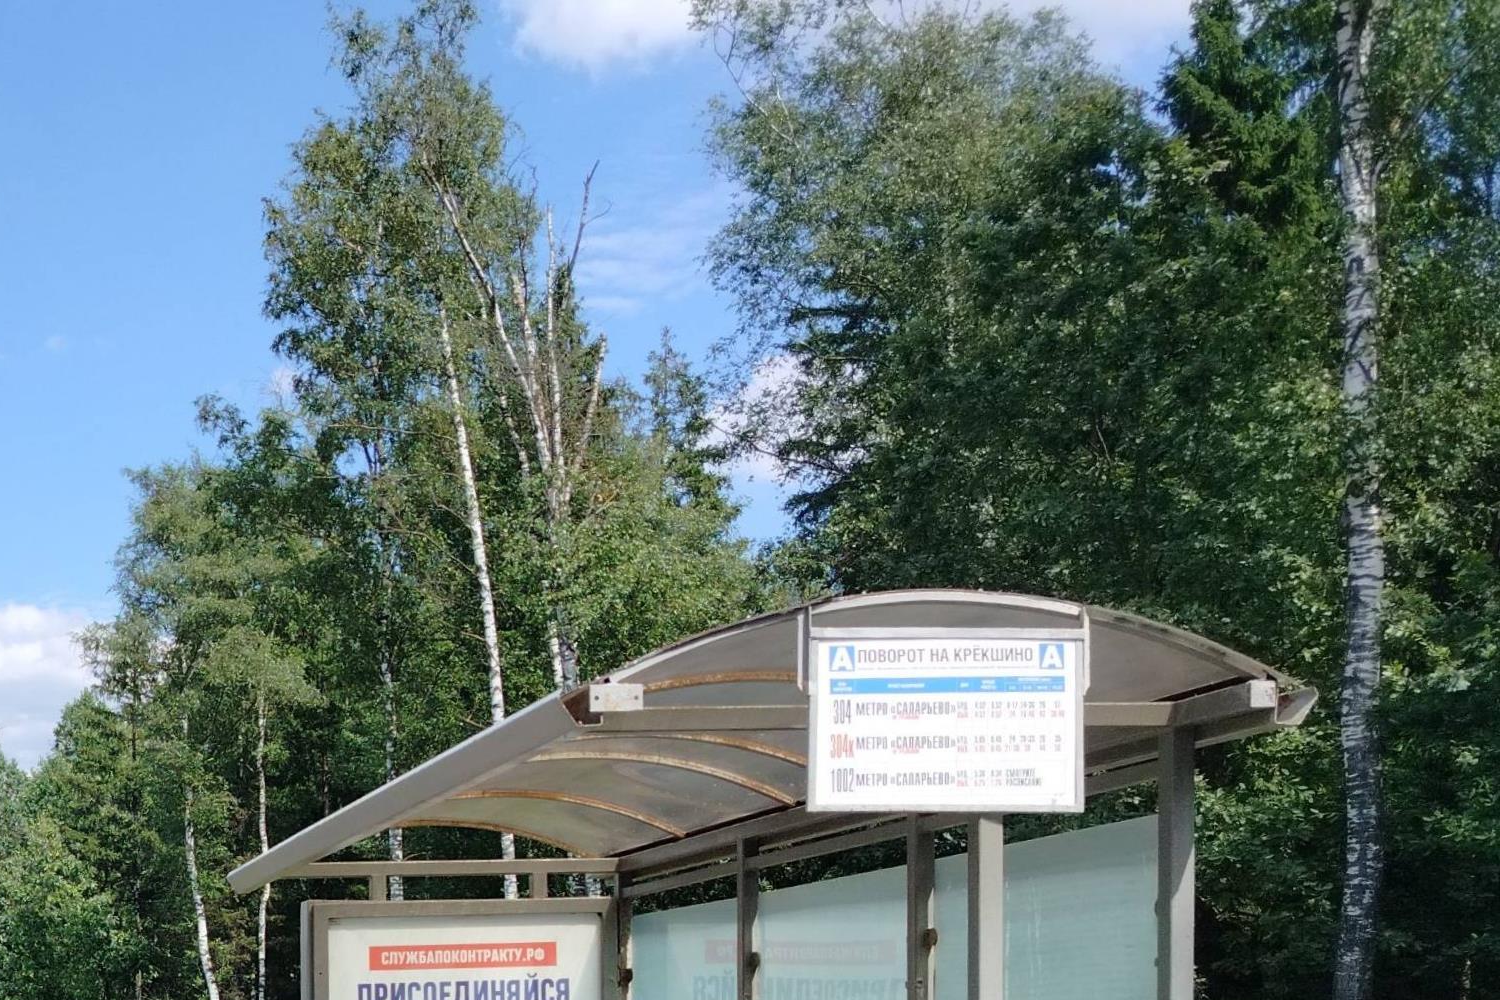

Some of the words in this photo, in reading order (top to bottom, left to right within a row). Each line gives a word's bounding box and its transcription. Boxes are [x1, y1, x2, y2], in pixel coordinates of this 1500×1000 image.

[857, 648, 924, 664] ПОВОРОТ
[930, 648, 949, 663] НА
[954, 645, 1033, 662] КРЁКШИНО
[833, 699, 851, 725] 304
[856, 702, 888, 716] МЕТРО
[856, 736, 888, 750] МЕТРО
[831, 768, 854, 793] 1002
[856, 773, 888, 787] МЕТРО
[381, 947, 545, 965] СЛУЖБАПОКОНТРАКТУ.РФ
